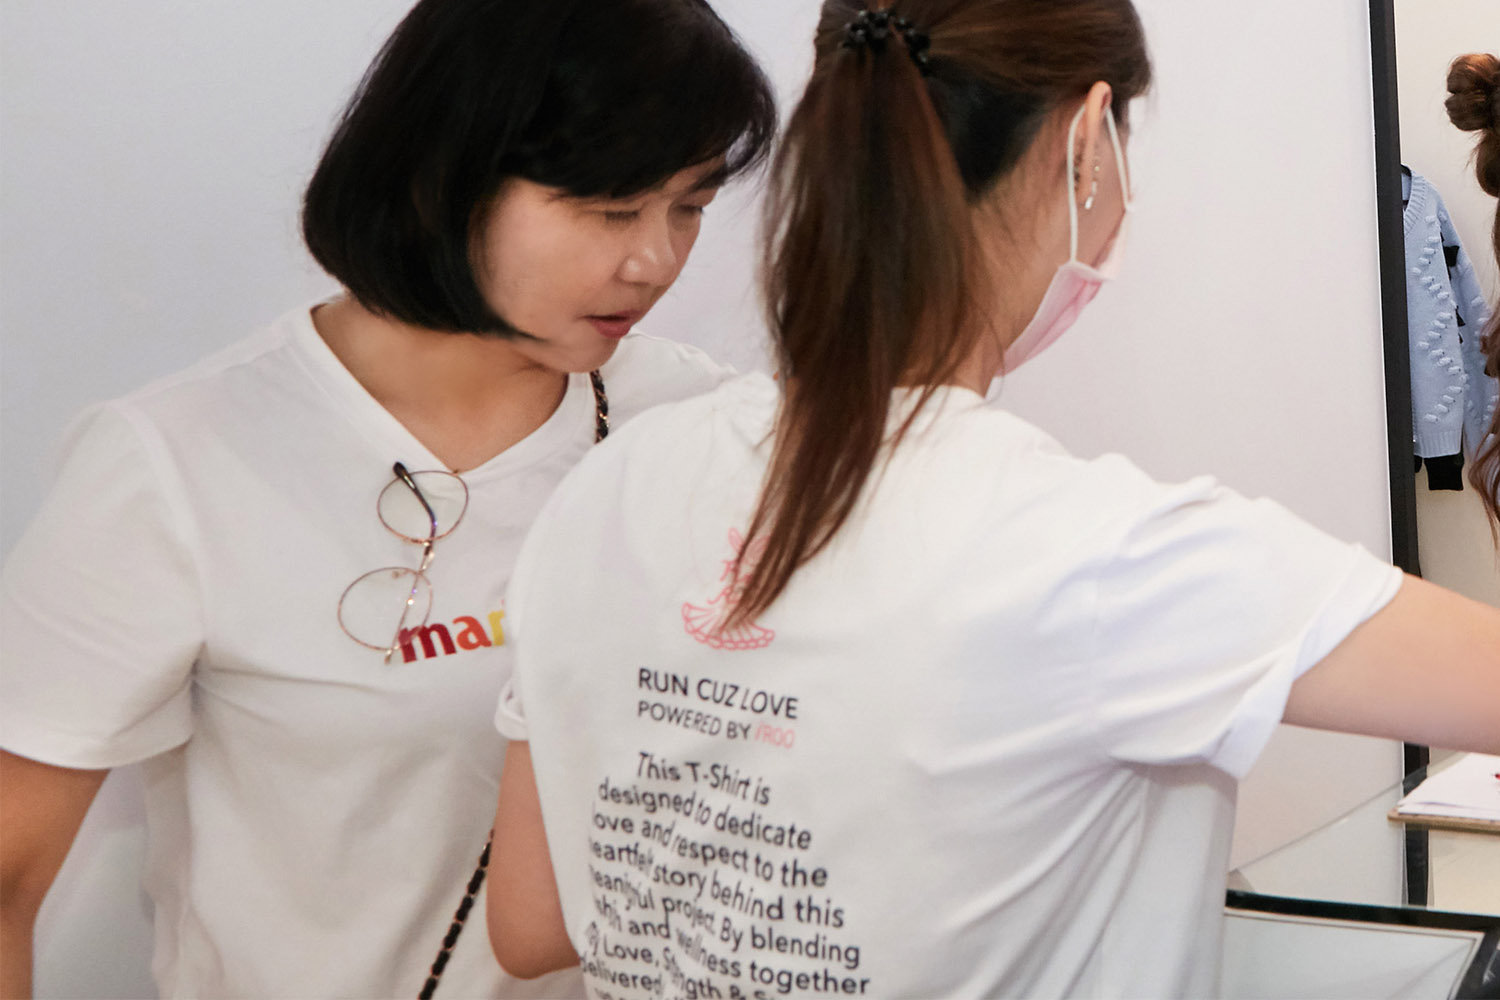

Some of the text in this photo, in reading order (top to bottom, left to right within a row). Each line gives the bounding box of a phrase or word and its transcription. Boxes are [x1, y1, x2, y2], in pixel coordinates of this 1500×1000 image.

[638, 668, 799, 719] RUN CUZ LOVE
[638, 701, 722, 736] POWERED
[726, 721, 751, 740] BY
[637, 751, 770, 805] This T-Shirt is
[599, 776, 811, 850] designed to dedicate
[641, 819, 676, 847] and
[672, 833, 748, 873] respect
[755, 853, 773, 882] to
[782, 858, 828, 888] the
[653, 864, 706, 902] story
[710, 869, 785, 921] behind
[794, 895, 845, 928] this
[628, 912, 670, 939] and
[750, 962, 870, 995] together
[720, 917, 743, 952] By
[751, 925, 860, 970] blending
